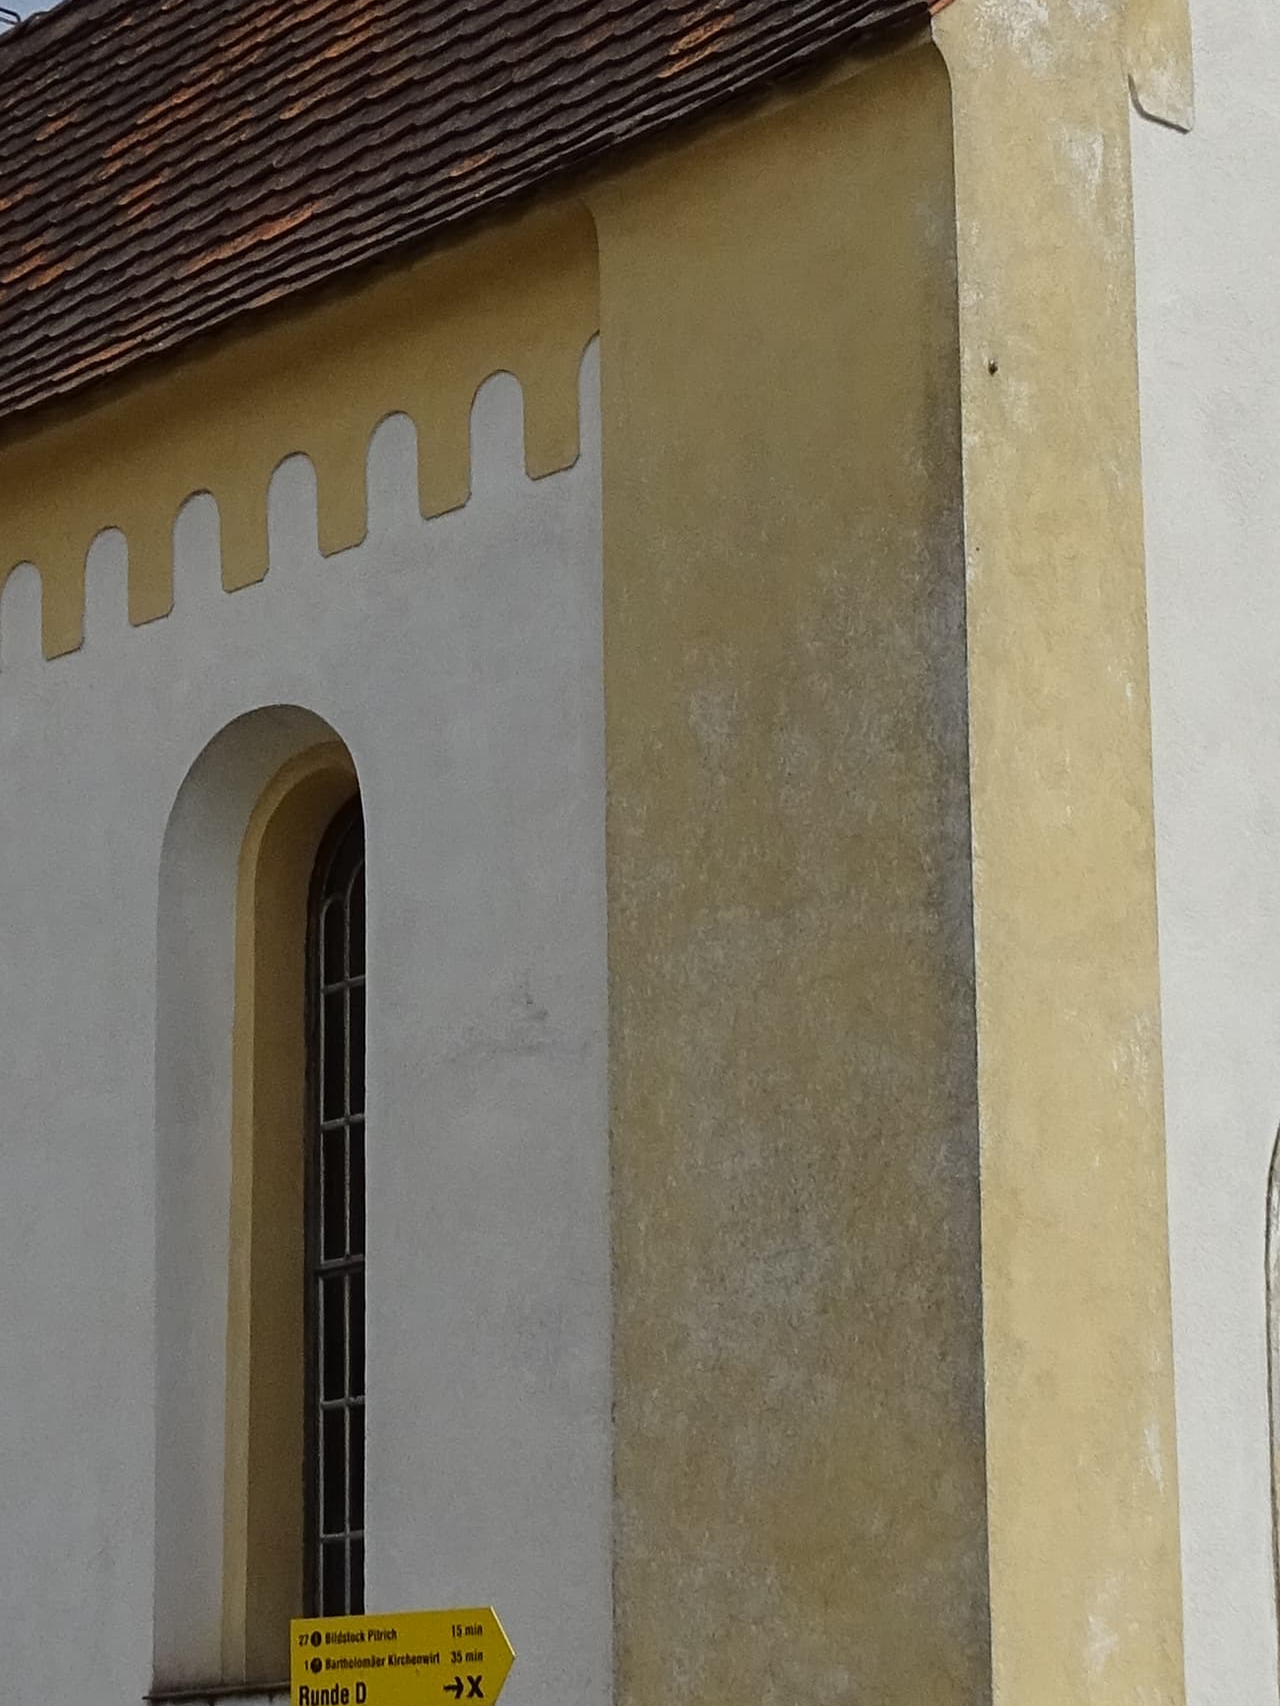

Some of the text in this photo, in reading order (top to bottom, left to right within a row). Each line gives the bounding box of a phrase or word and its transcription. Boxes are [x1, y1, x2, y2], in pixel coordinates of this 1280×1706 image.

[298, 1634, 309, 1647] 27
[325, 1630, 365, 1645] Bildstock
[452, 1624, 462, 1638] 15
[465, 1624, 483, 1636] min
[388, 1652, 440, 1667] Kirchenwirt
[450, 1650, 462, 1664] 35
[465, 1649, 483, 1662] min
[355, 1681, 367, 1704] D
